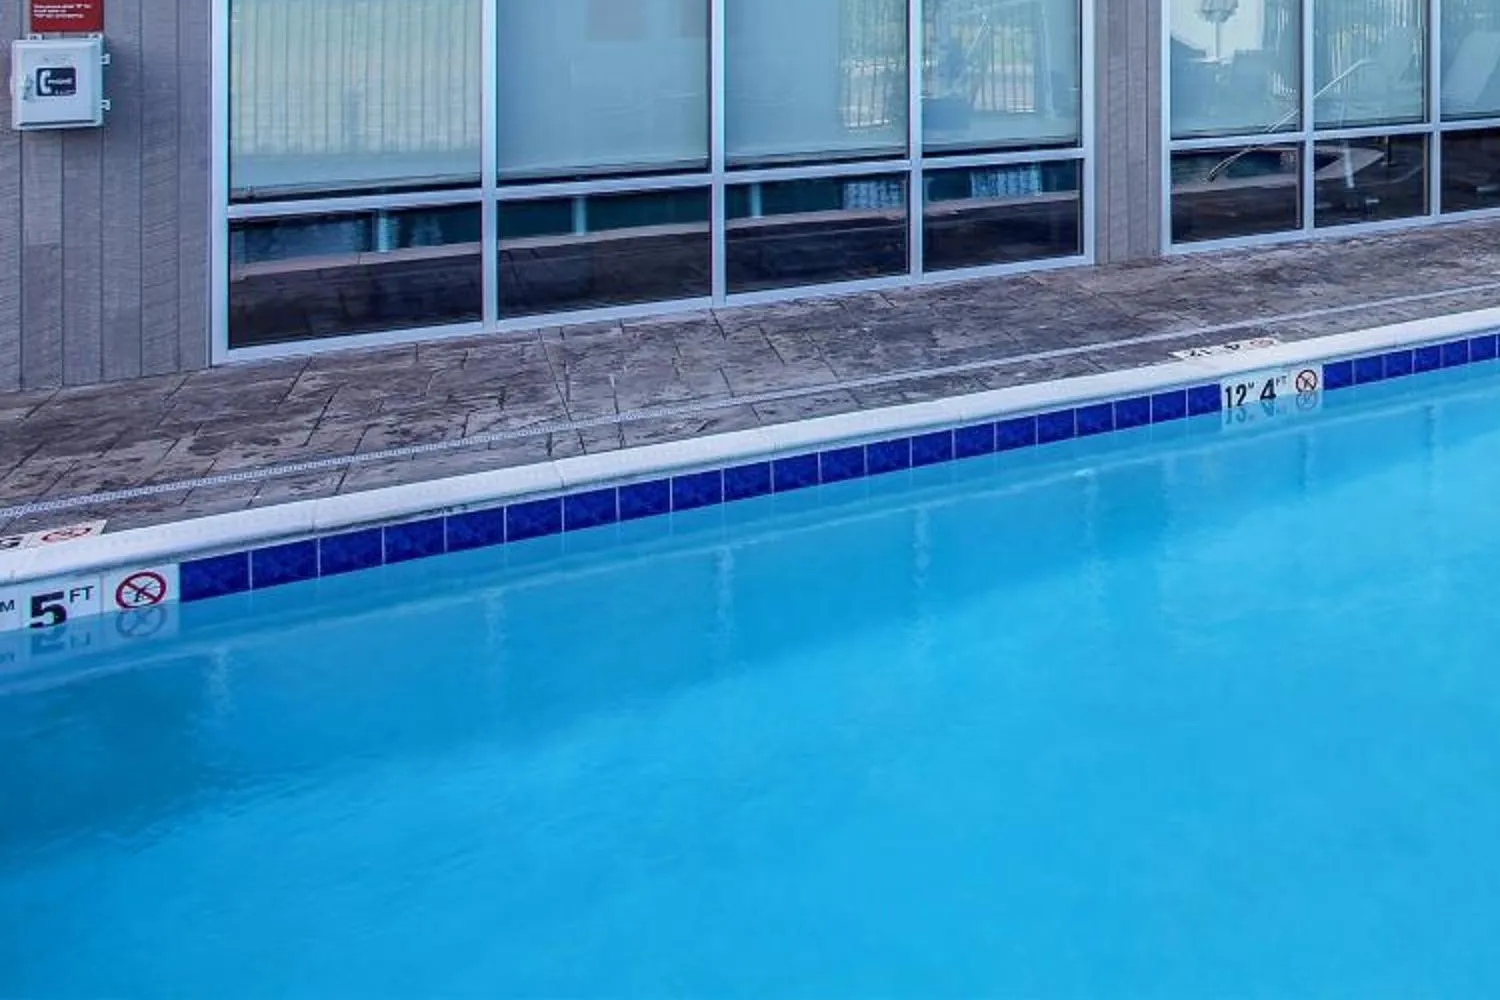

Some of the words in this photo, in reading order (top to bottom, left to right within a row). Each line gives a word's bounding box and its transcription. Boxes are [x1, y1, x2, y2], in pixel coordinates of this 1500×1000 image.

[1260, 377, 1276, 400] 4
[30, 591, 67, 629] 5
[70, 585, 94, 603] FT
